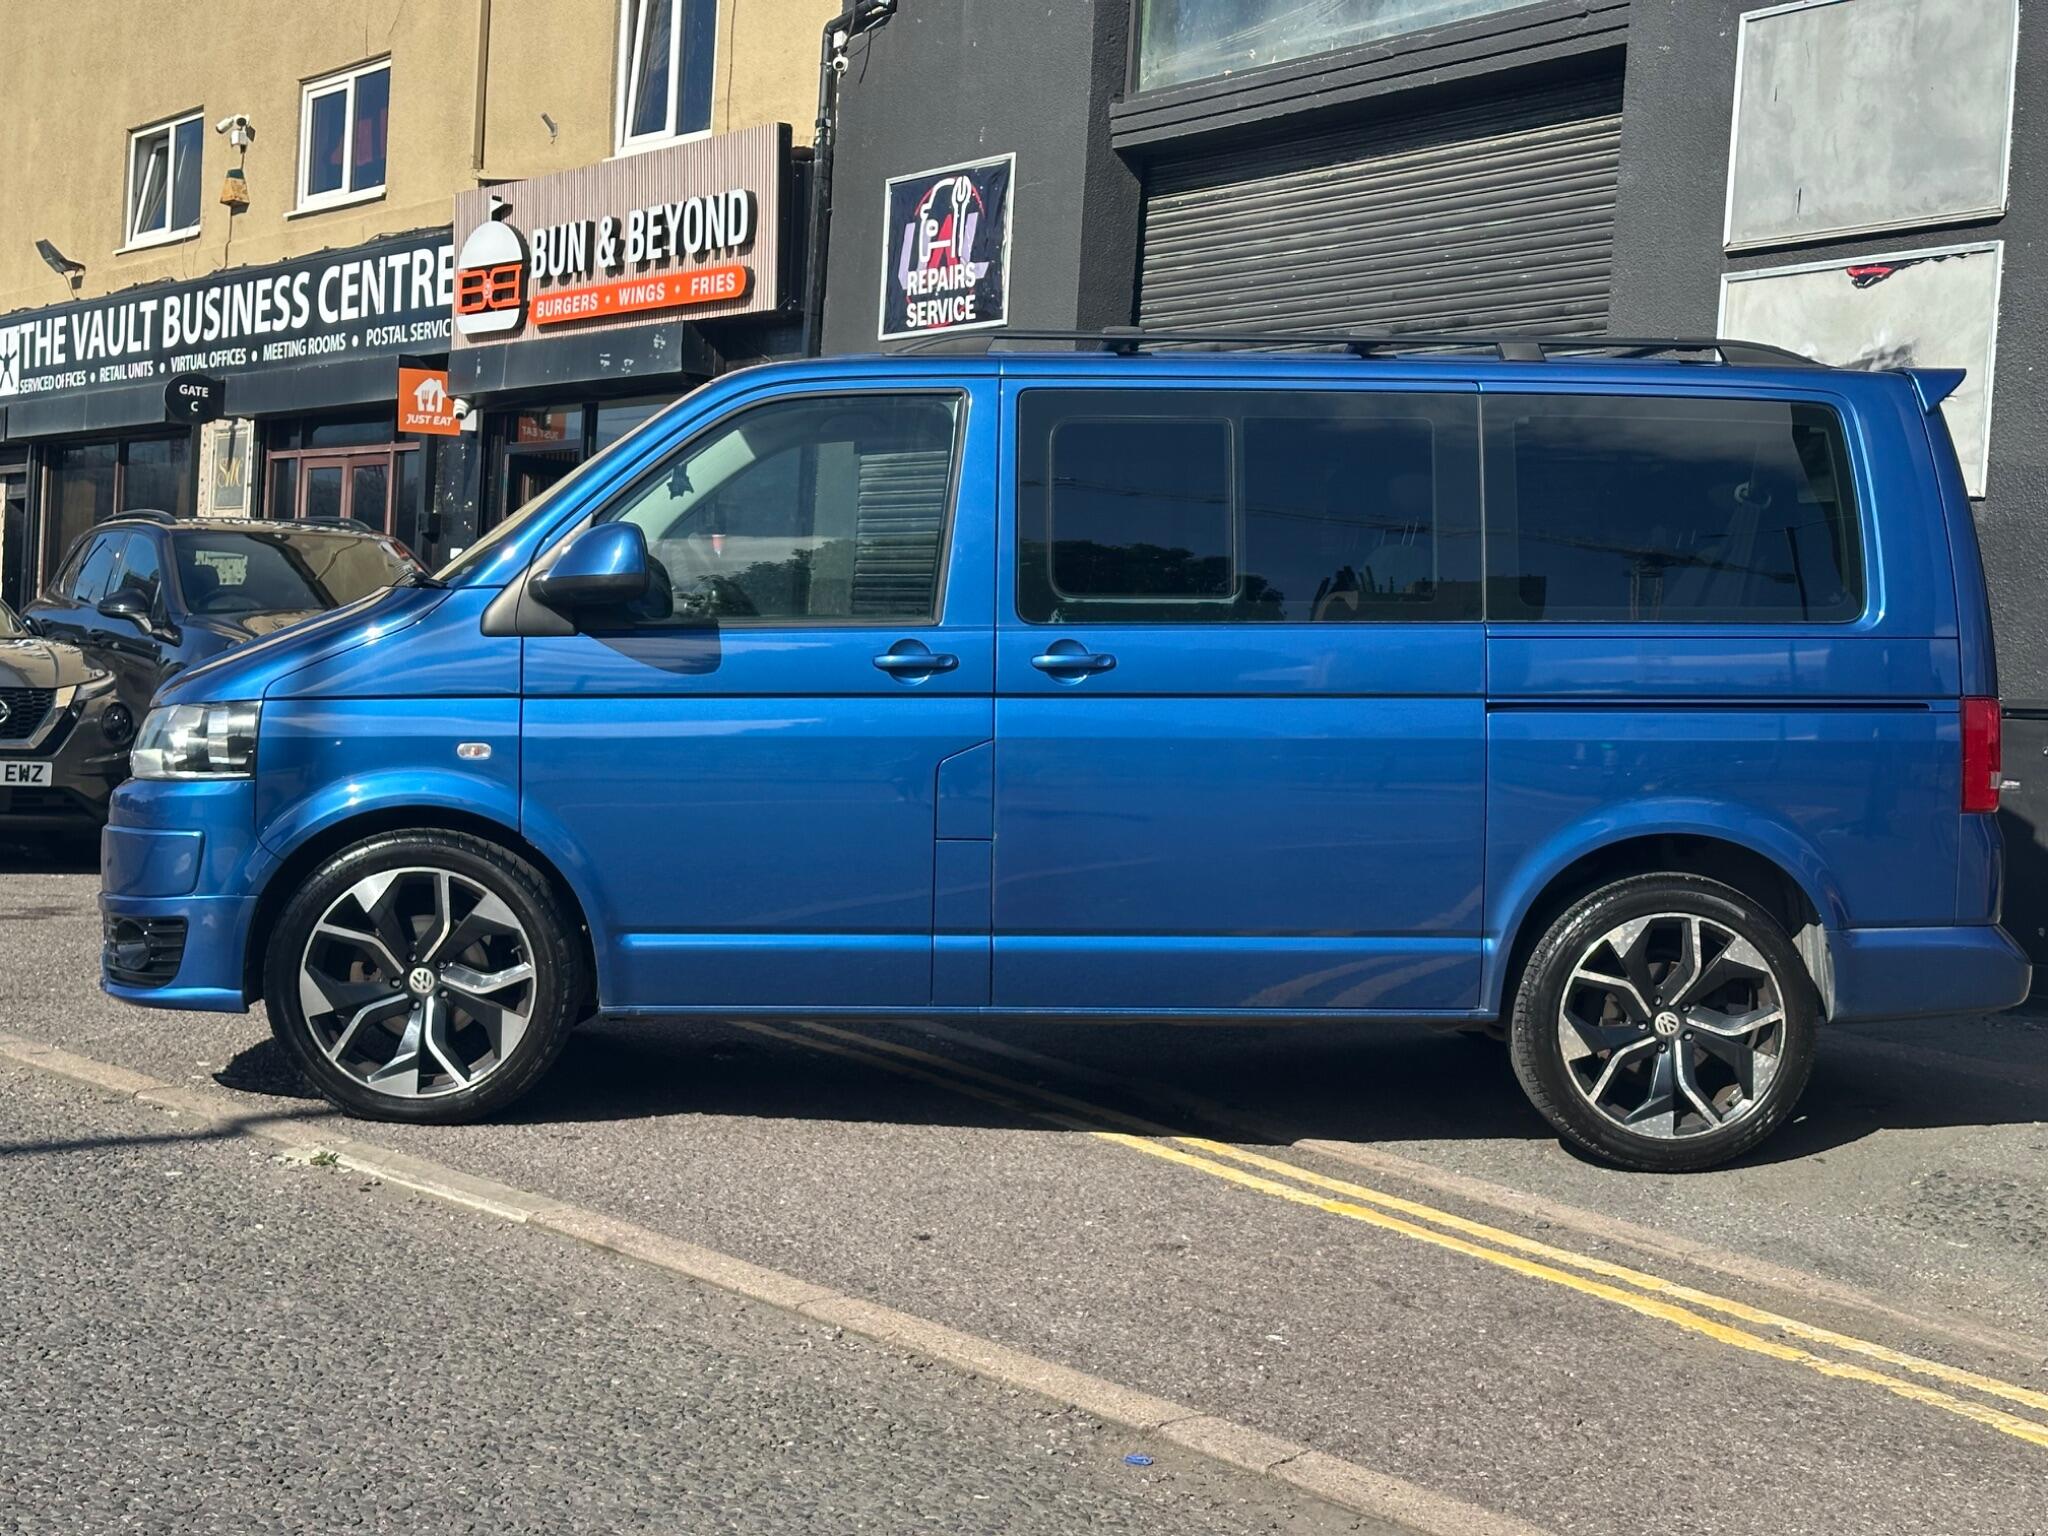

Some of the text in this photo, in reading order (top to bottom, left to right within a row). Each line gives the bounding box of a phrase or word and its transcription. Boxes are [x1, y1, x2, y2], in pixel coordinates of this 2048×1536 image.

[531, 188, 749, 279] BUN & BEYOND
[536, 272, 735, 318] BURGERS WINGS FRIES
[906, 263, 976, 297] REPAIRS
[19, 245, 454, 370] THE VAULT BUSINESS CENTRE
[906, 295, 976, 327] SERVICE
[19, 376, 54, 394] SERVICED
[100, 363, 127, 382] RETAIL
[128, 360, 153, 380] UNITS
[170, 351, 208, 373] VIRTUAL
[209, 347, 247, 367] OFFICES
[263, 339, 307, 361] MEETING
[308, 332, 346, 355] ROOMS
[366, 324, 407, 347] POSTAL
[179, 384, 209, 398] GATE
[190, 401, 199, 412] C
[405, 413, 453, 427] JUST EAT
[5, 764, 44, 782] EWZ
